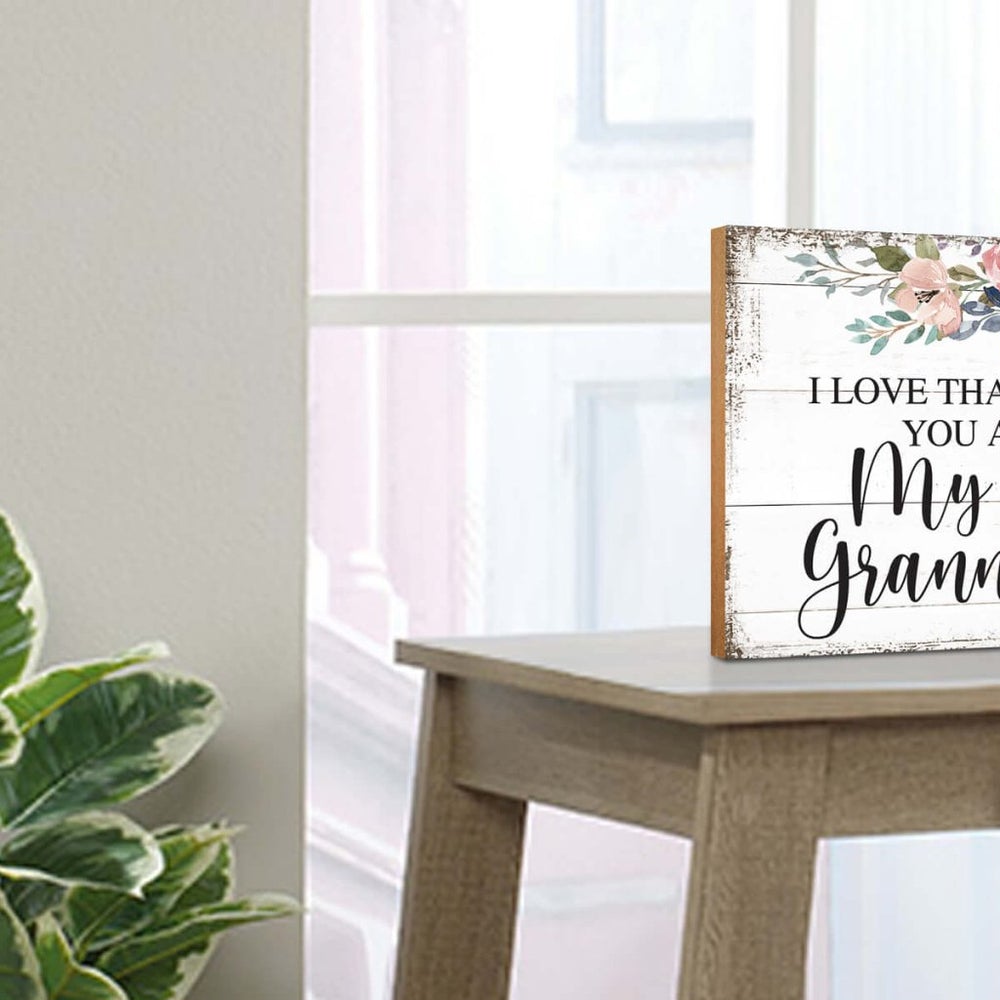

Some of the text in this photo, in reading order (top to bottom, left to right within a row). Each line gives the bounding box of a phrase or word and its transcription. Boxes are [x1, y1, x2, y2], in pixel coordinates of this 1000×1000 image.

[808, 376, 820, 405] I
[832, 376, 928, 405] LOVE
[902, 419, 977, 447] YOU
[851, 440, 994, 537] My
